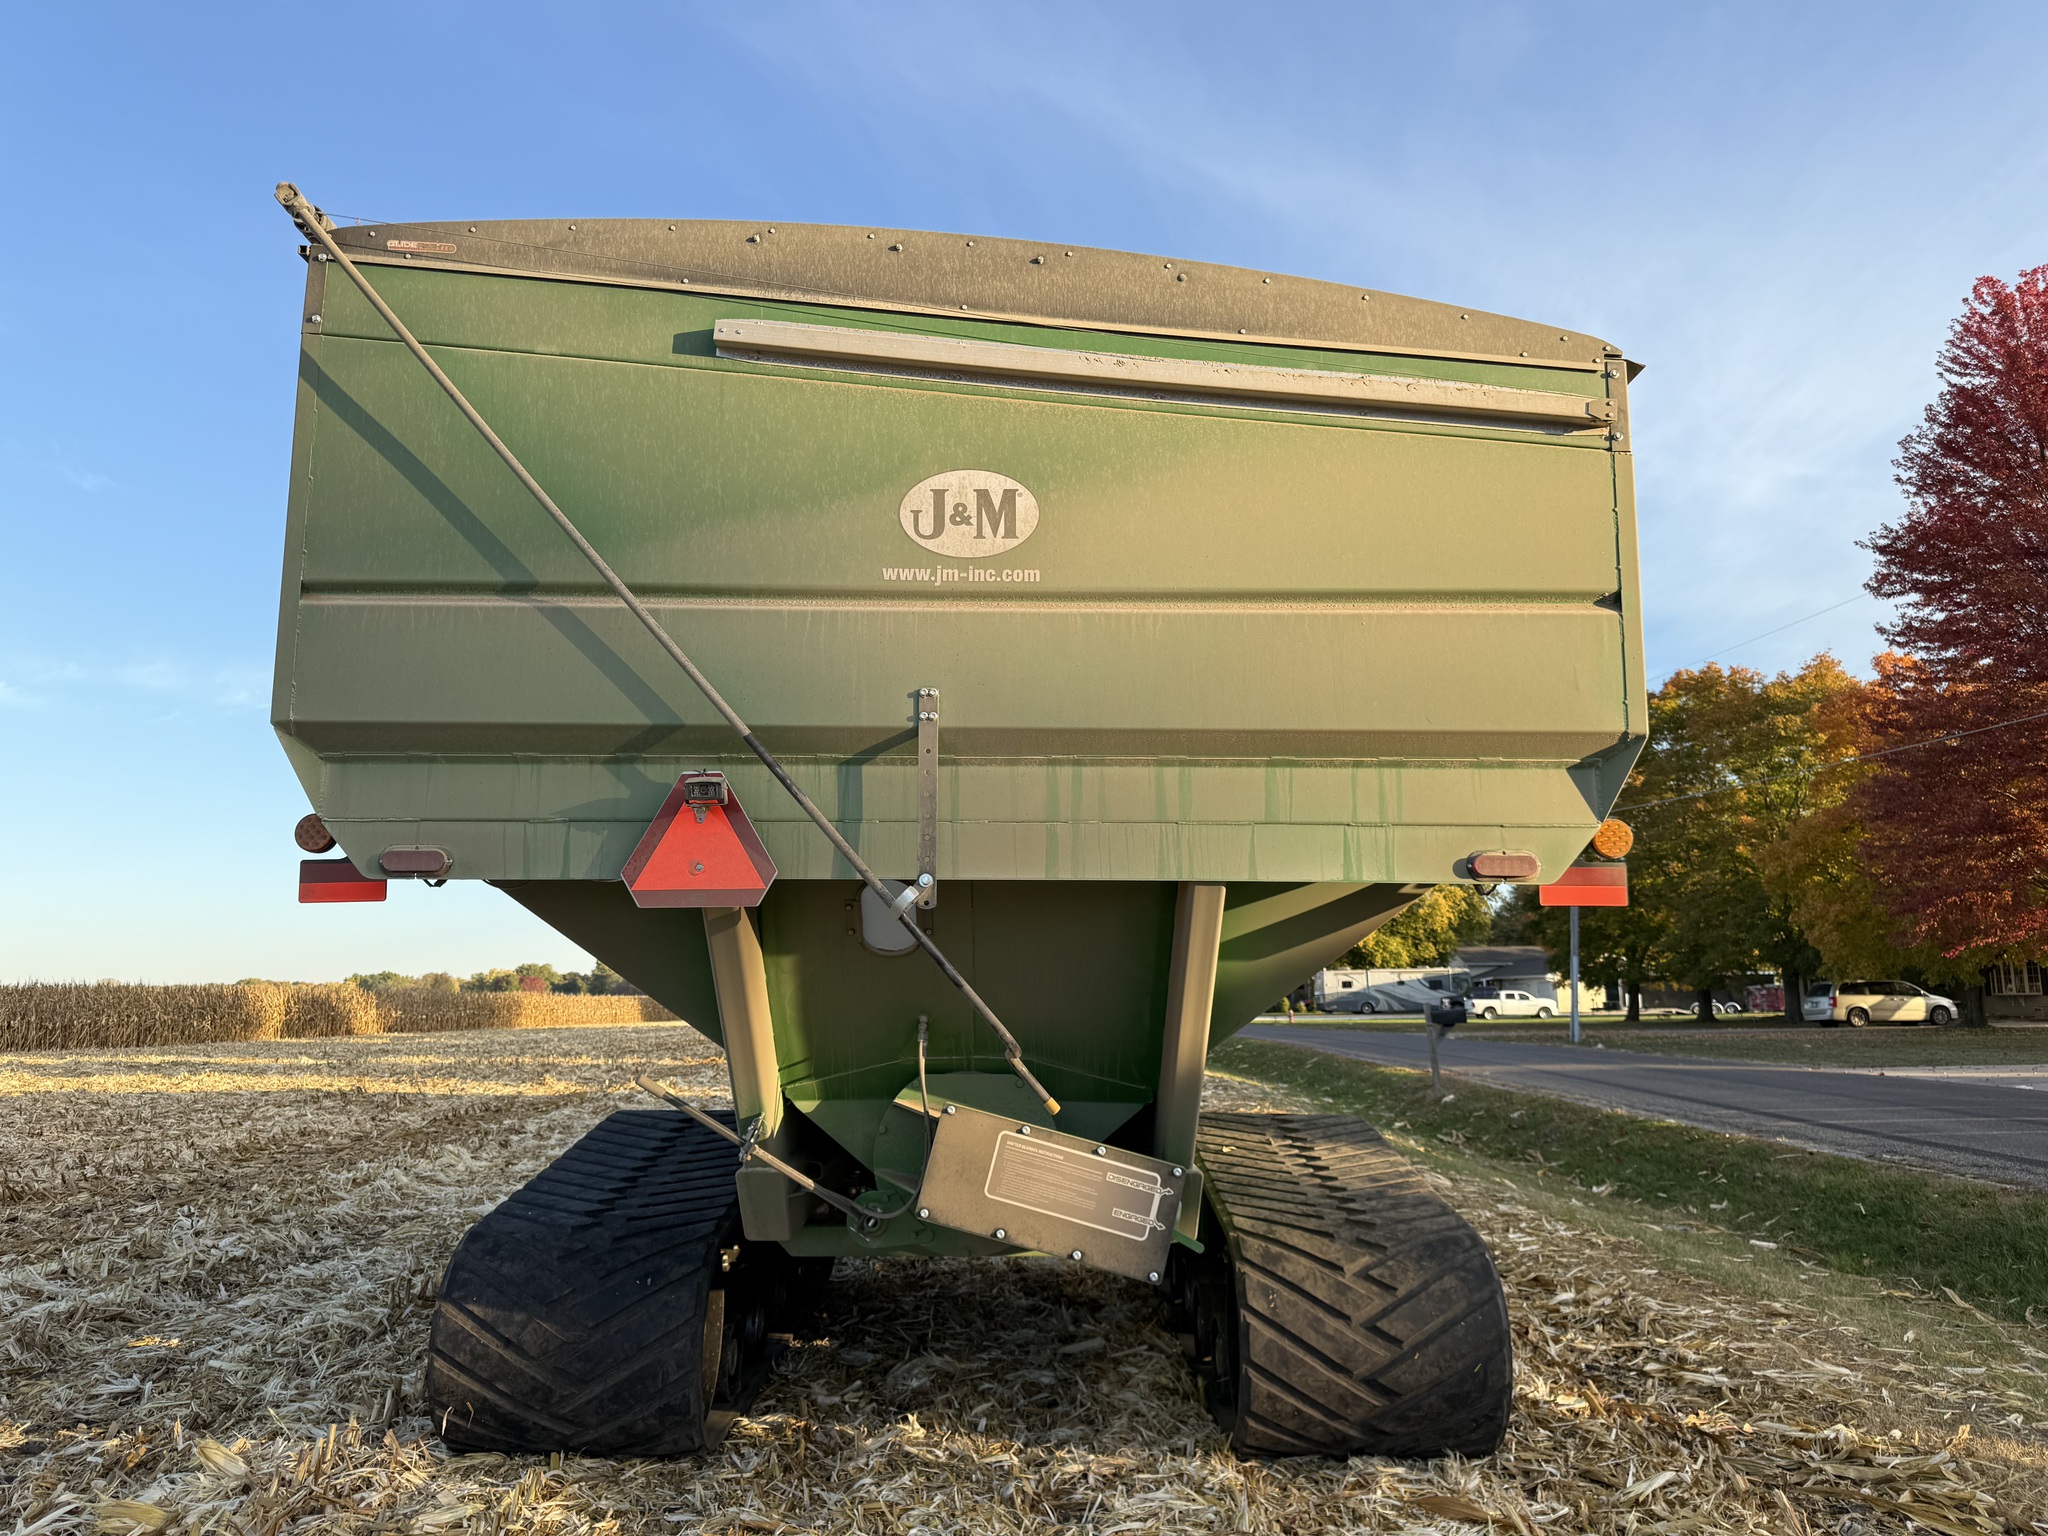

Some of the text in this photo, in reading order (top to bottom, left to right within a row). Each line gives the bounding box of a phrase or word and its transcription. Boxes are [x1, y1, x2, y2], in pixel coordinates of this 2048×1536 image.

[910, 488, 1020, 541] J&M
[882, 565, 1041, 586] www.jm-inc.com
[1107, 1174, 1162, 1195] DISENGAGED
[1113, 1209, 1155, 1226] ENGAGED
